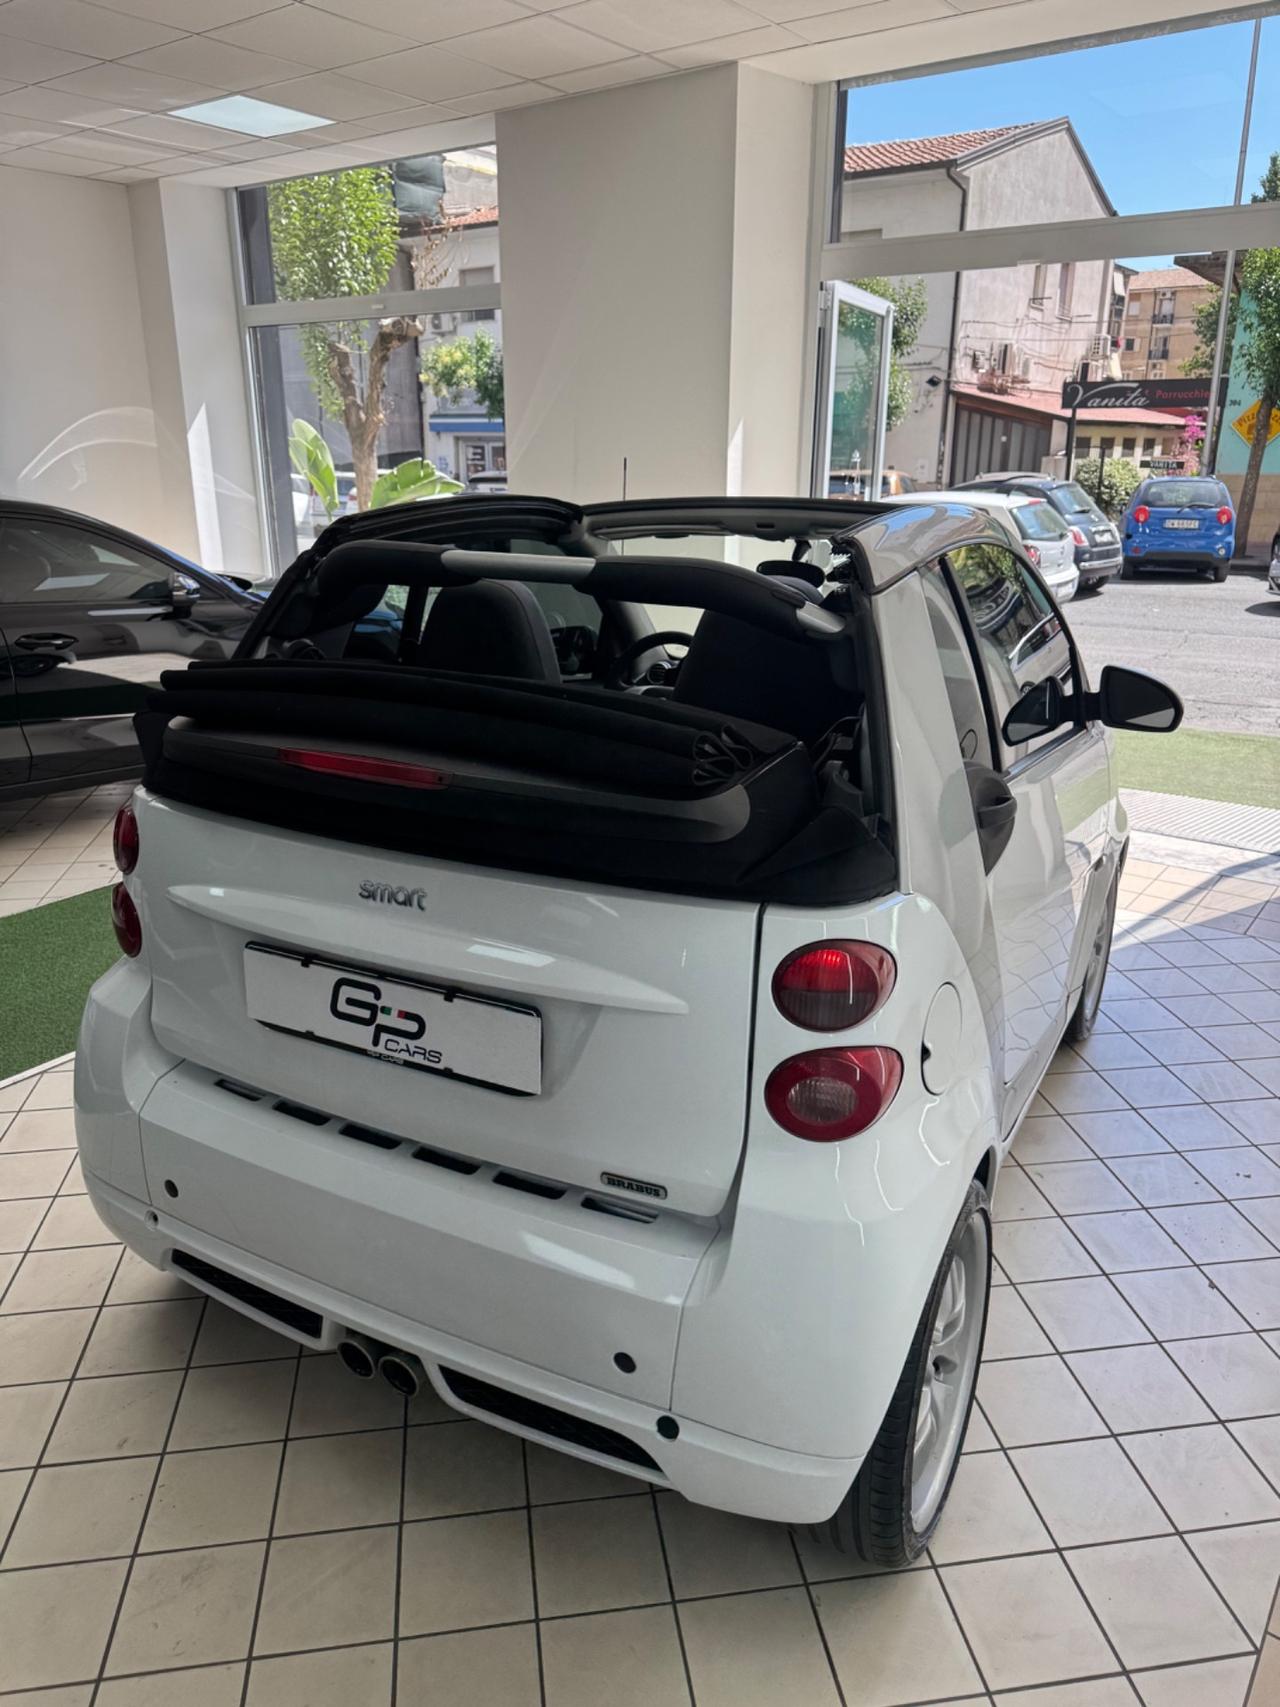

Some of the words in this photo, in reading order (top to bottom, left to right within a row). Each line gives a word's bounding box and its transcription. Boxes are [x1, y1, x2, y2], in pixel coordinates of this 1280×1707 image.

[359, 880, 428, 912] smart
[384, 1039, 442, 1065] CARS
[606, 1177, 661, 1198] BRABUS
